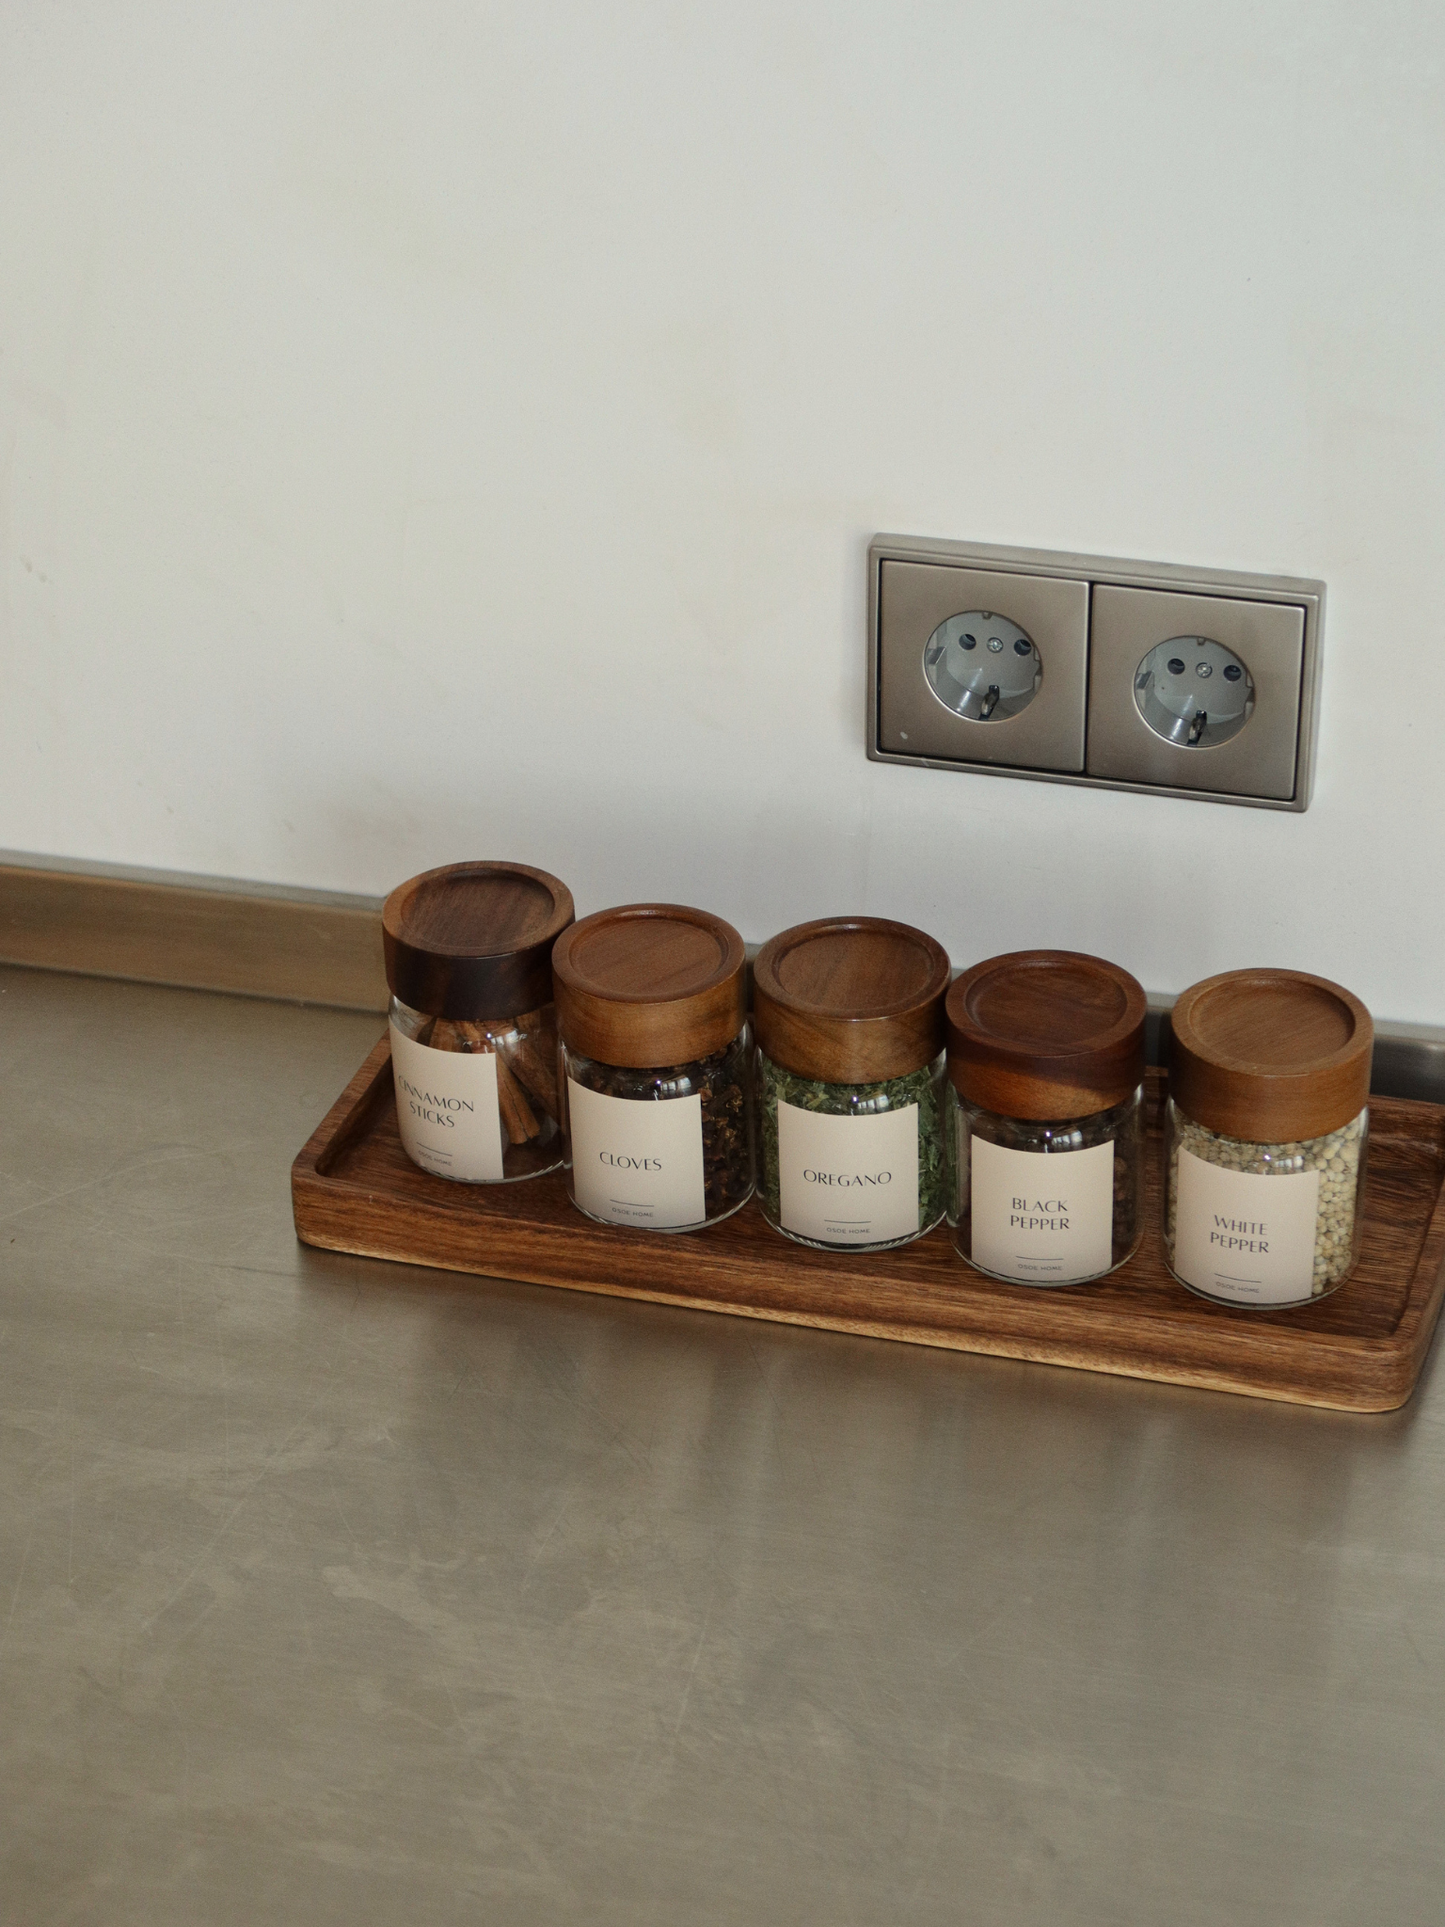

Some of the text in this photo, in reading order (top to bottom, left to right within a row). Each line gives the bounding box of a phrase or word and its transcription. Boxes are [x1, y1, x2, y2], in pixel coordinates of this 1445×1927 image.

[410, 1101, 455, 1128] STICKS
[599, 1151, 662, 1171] CLOVES
[803, 1169, 892, 1187] OREGANO
[1012, 1197, 1068, 1213] BLACK
[1010, 1215, 1070, 1231] PEPPER
[1214, 1214, 1268, 1236] WHITE
[1210, 1231, 1269, 1253] PEPPER
